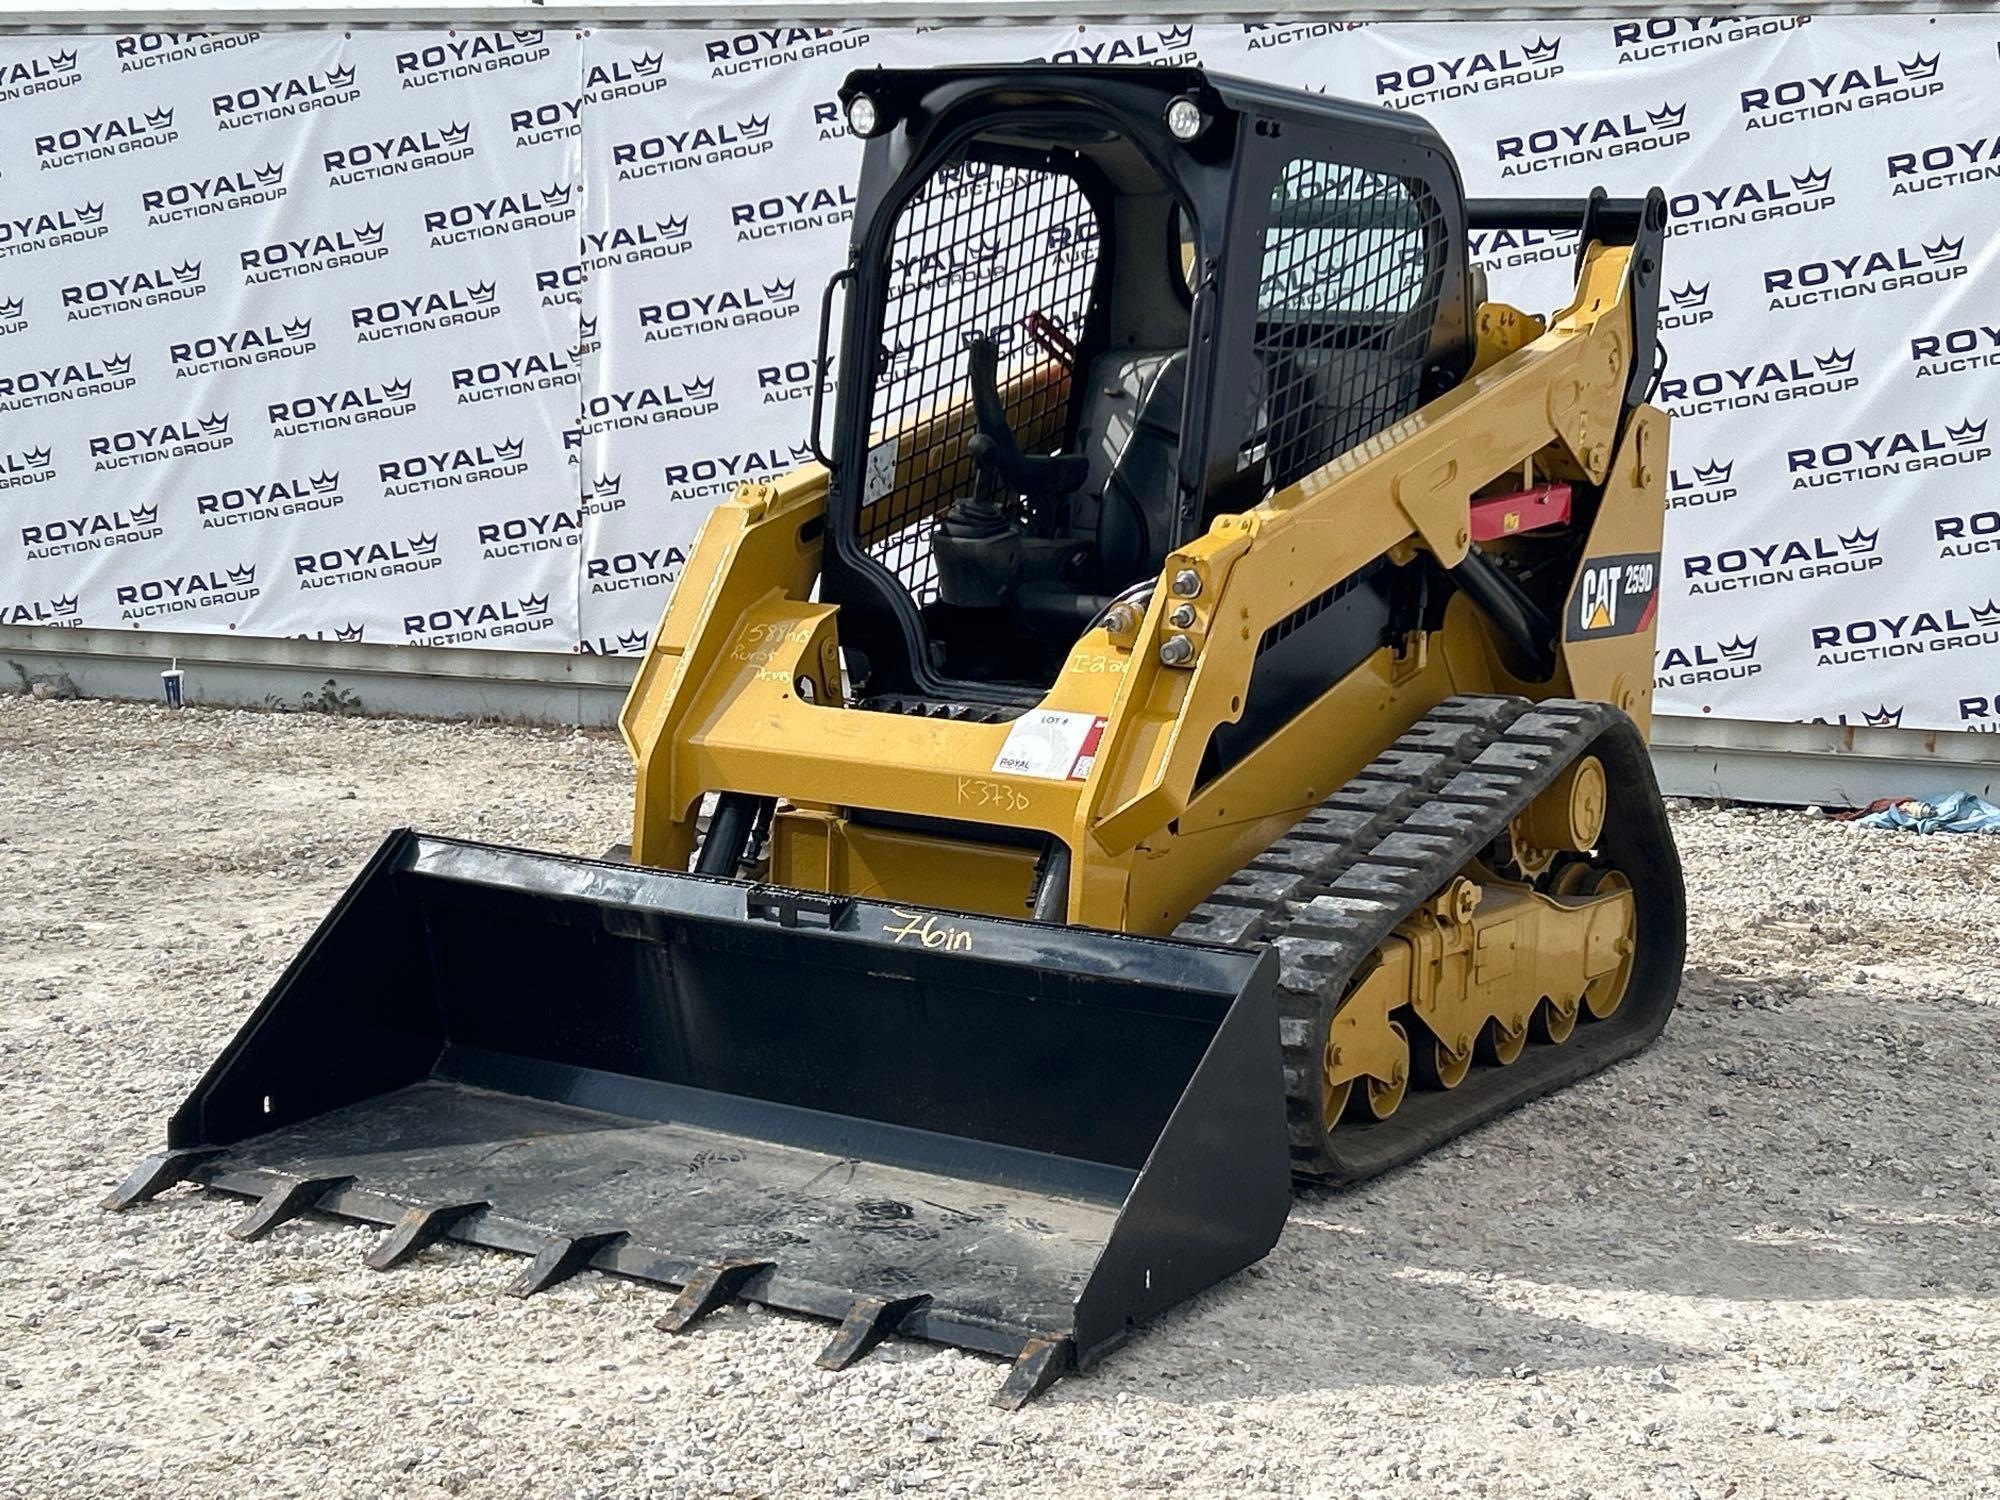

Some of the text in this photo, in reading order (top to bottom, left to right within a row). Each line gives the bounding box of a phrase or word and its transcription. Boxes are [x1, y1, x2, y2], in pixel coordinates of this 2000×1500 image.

[116, 33, 212, 59] ROY
[1024, 36, 1158, 64] OYAL
[1247, 22, 1345, 52] AUCTION
[1613, 16, 1757, 47] ROY
[1618, 32, 1723, 64] AUCTION
[121, 30, 260, 73] AUCTION GROUP
[396, 32, 515, 75] ROYAL
[402, 48, 550, 90] AUCTION GROUP
[711, 34, 870, 79] AUCTION GROUP
[23, 74, 82, 96] GROUP
[601, 78, 667, 101] GROUP
[1376, 49, 1522, 95] ROYAL
[1484, 65, 1564, 91] GROUP
[1740, 65, 1898, 114] ROYAL
[212, 75, 326, 117] ROYAL
[218, 90, 360, 131] AUCTION GROUP
[1745, 82, 1944, 131] AUCTION GROUP
[510, 98, 583, 133] ROY
[35, 117, 146, 156] ROYAL
[40, 131, 178, 171] AUCTION GROUP
[323, 132, 440, 173] ROYAL
[516, 124, 582, 148] AUCTIO
[613, 125, 738, 166] ROYAL
[1496, 114, 1647, 161] ROYAL
[1501, 131, 1690, 178] AUCTION GROUP
[329, 147, 474, 188] AUCTION GROUP
[618, 140, 773, 182] AUCTION GROUP
[1887, 136, 2000, 178] ROY
[142, 172, 256, 212] ROYAL
[148, 187, 287, 227] AUCTION GROUP
[732, 186, 857, 226] ROYAL
[1669, 179, 1791, 218] OYAL
[0, 211, 76, 242] OYAL
[424, 193, 542, 233] ROYAL
[430, 209, 576, 248] AUCTION GROUP
[737, 215, 823, 242] AUCTION
[1663, 196, 1835, 240] UCTION GROUP
[49, 226, 108, 247] GROUP
[240, 232, 355, 271] ROYAL
[580, 224, 657, 256] YAL
[245, 247, 389, 286] AUCTION GROUP
[580, 241, 692, 272] TION GROUP
[1764, 247, 1922, 293] ROYAL
[61, 269, 173, 308] ROYAL
[67, 285, 206, 322] AUCTION GROUP
[1769, 265, 1968, 311] AUCTION GROUP
[351, 290, 468, 329] ROYAL
[357, 306, 501, 343] AUCTION GROUP
[639, 288, 763, 327] ROYAL
[645, 304, 800, 343] AUCTION GROUP
[170, 326, 284, 365] ROYAL
[176, 342, 316, 379] AUCTION GROUP
[1911, 326, 2000, 360] ROY
[0, 362, 104, 398] ROYAL
[451, 352, 568, 390] ROYAL
[758, 355, 836, 388] ROY
[1660, 359, 1814, 403] ROYAL
[1915, 353, 2000, 378] AUCTIO
[0, 377, 136, 413] AUCTION GROUP
[268, 387, 383, 425] ROYAL
[457, 372, 582, 405] AUCTION GRO
[1667, 377, 1859, 420] AUCTION GROUP
[273, 403, 416, 439] AUCTION GROUP
[581, 402, 719, 436] UCTION GROUP
[89, 421, 200, 458] ROYAL
[94, 437, 233, 472] AUCTION GROUP
[1787, 429, 1946, 472] ROYAL
[378, 446, 495, 485] ROYAL
[384, 463, 528, 498] AUCTION GROUP
[665, 449, 791, 487] ROYAL
[1792, 448, 1992, 490] AUCTION GROUP
[197, 479, 310, 516] ROYAL
[203, 496, 344, 529] AUCTION GROUP
[582, 499, 626, 516] ROUP
[21, 512, 130, 547] ROYAL
[27, 527, 163, 561] AUCTION GROUP
[478, 512, 583, 546] ROYA
[294, 541, 409, 576] ROYAL
[483, 537, 562, 560] AUCTION
[588, 544, 692, 580] ROYA
[1683, 537, 1839, 579] ROYAL
[116, 572, 228, 606] ROYAL
[300, 557, 442, 590] AUCTION GROUP
[592, 572, 674, 594] AUCTION
[1688, 557, 1883, 596] AUCTION GROUP
[122, 588, 260, 620] AUCTION GROUP
[1581, 564, 1653, 630] CAT 259D
[403, 601, 519, 636] ROYAL
[490, 618, 554, 637] GROUP
[1812, 609, 1970, 649] ROYAL
[1817, 631, 1999, 667] AUCTION GROU
[1680, 664, 1762, 685] GROUP
[1041, 716, 1061, 725] LOT
[883, 907, 972, 952] 76in
